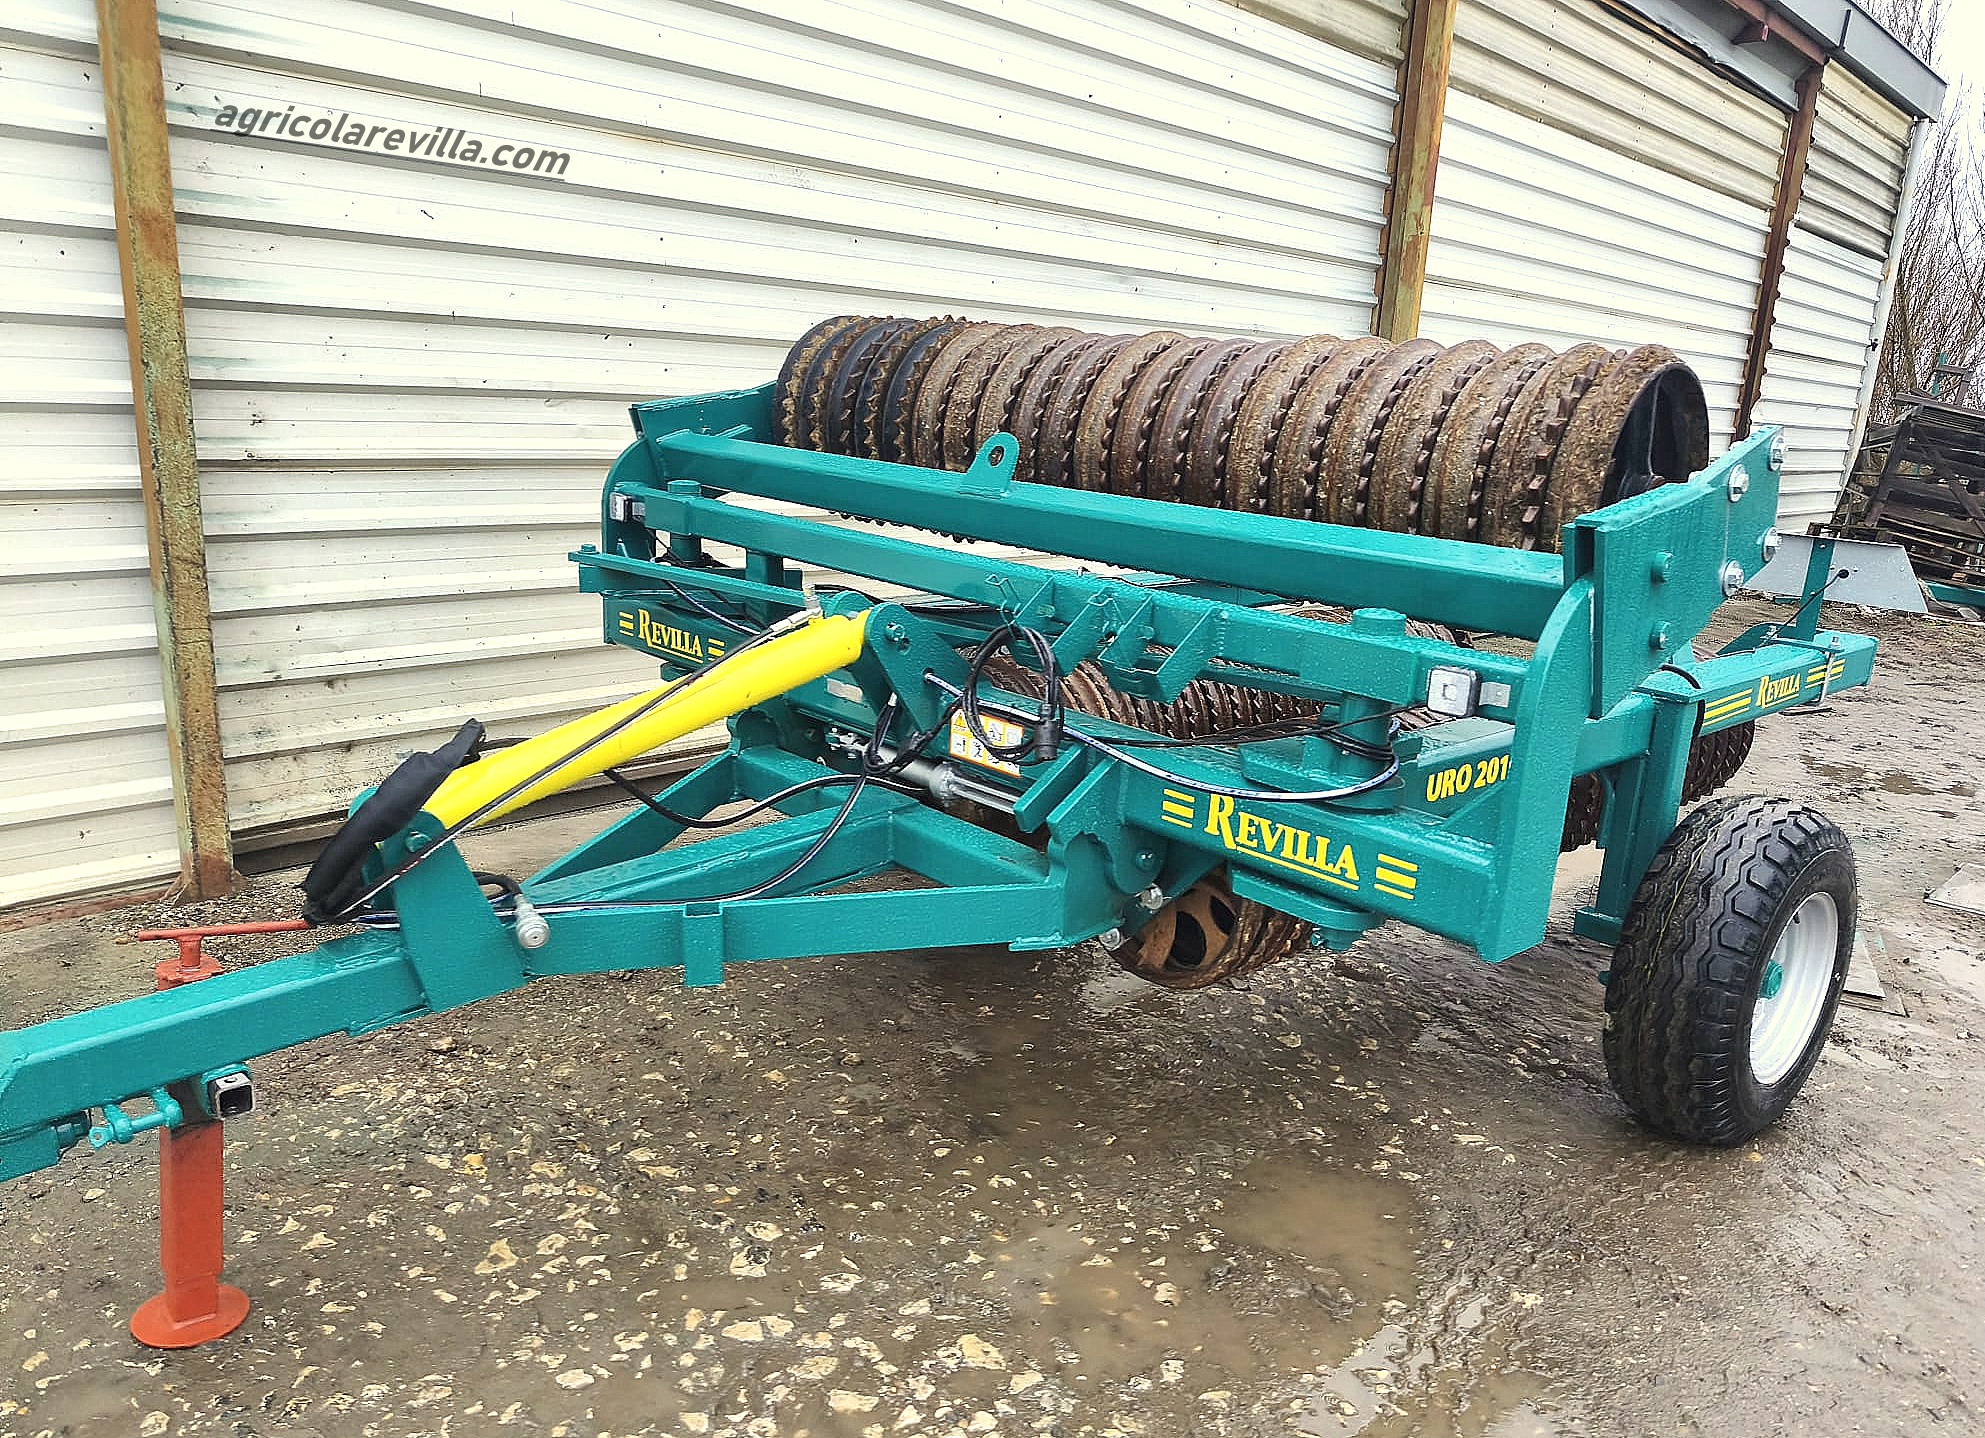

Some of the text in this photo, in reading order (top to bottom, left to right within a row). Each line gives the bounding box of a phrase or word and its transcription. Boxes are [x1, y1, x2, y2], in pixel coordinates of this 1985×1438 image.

[637, 608, 703, 662] REVILLA
[1755, 672, 1801, 709] REVILLA
[1426, 763, 1473, 802] URO
[1204, 794, 1360, 889] REVILLA
